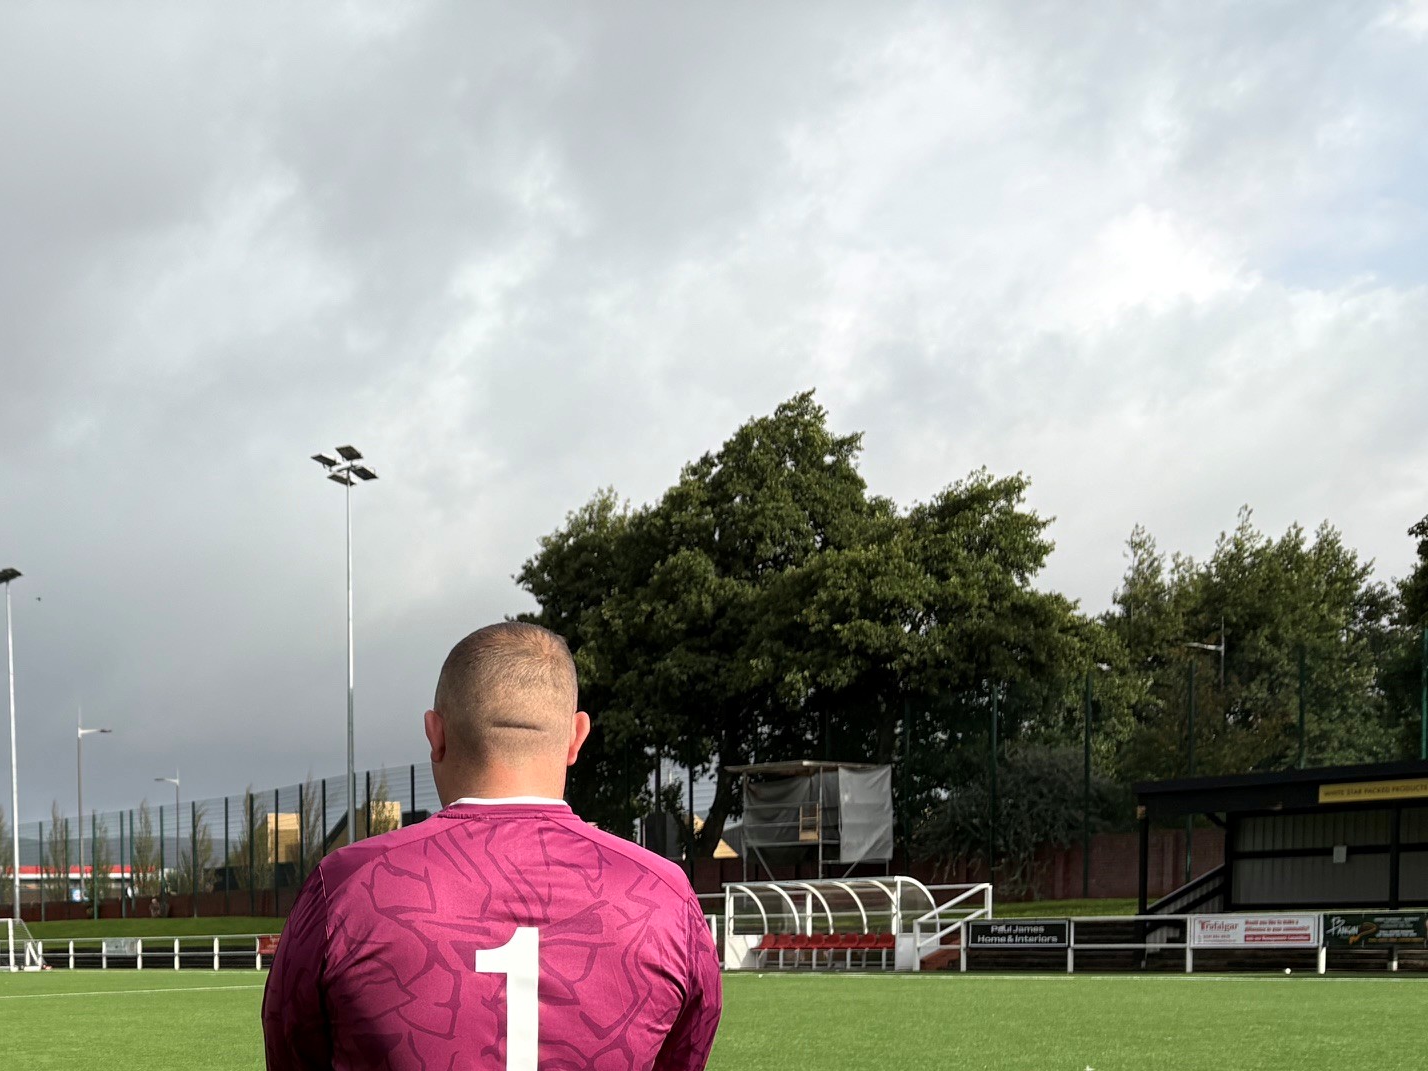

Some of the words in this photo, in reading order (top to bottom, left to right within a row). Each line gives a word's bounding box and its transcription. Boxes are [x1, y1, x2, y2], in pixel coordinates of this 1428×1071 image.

[990, 925, 1012, 934] Paul
[1013, 925, 1045, 934] James
[1199, 920, 1239, 932] Trafalgar
[977, 935, 1006, 943] Home
[1006, 935, 1014, 943] &
[1014, 933, 1058, 943] Interiors
